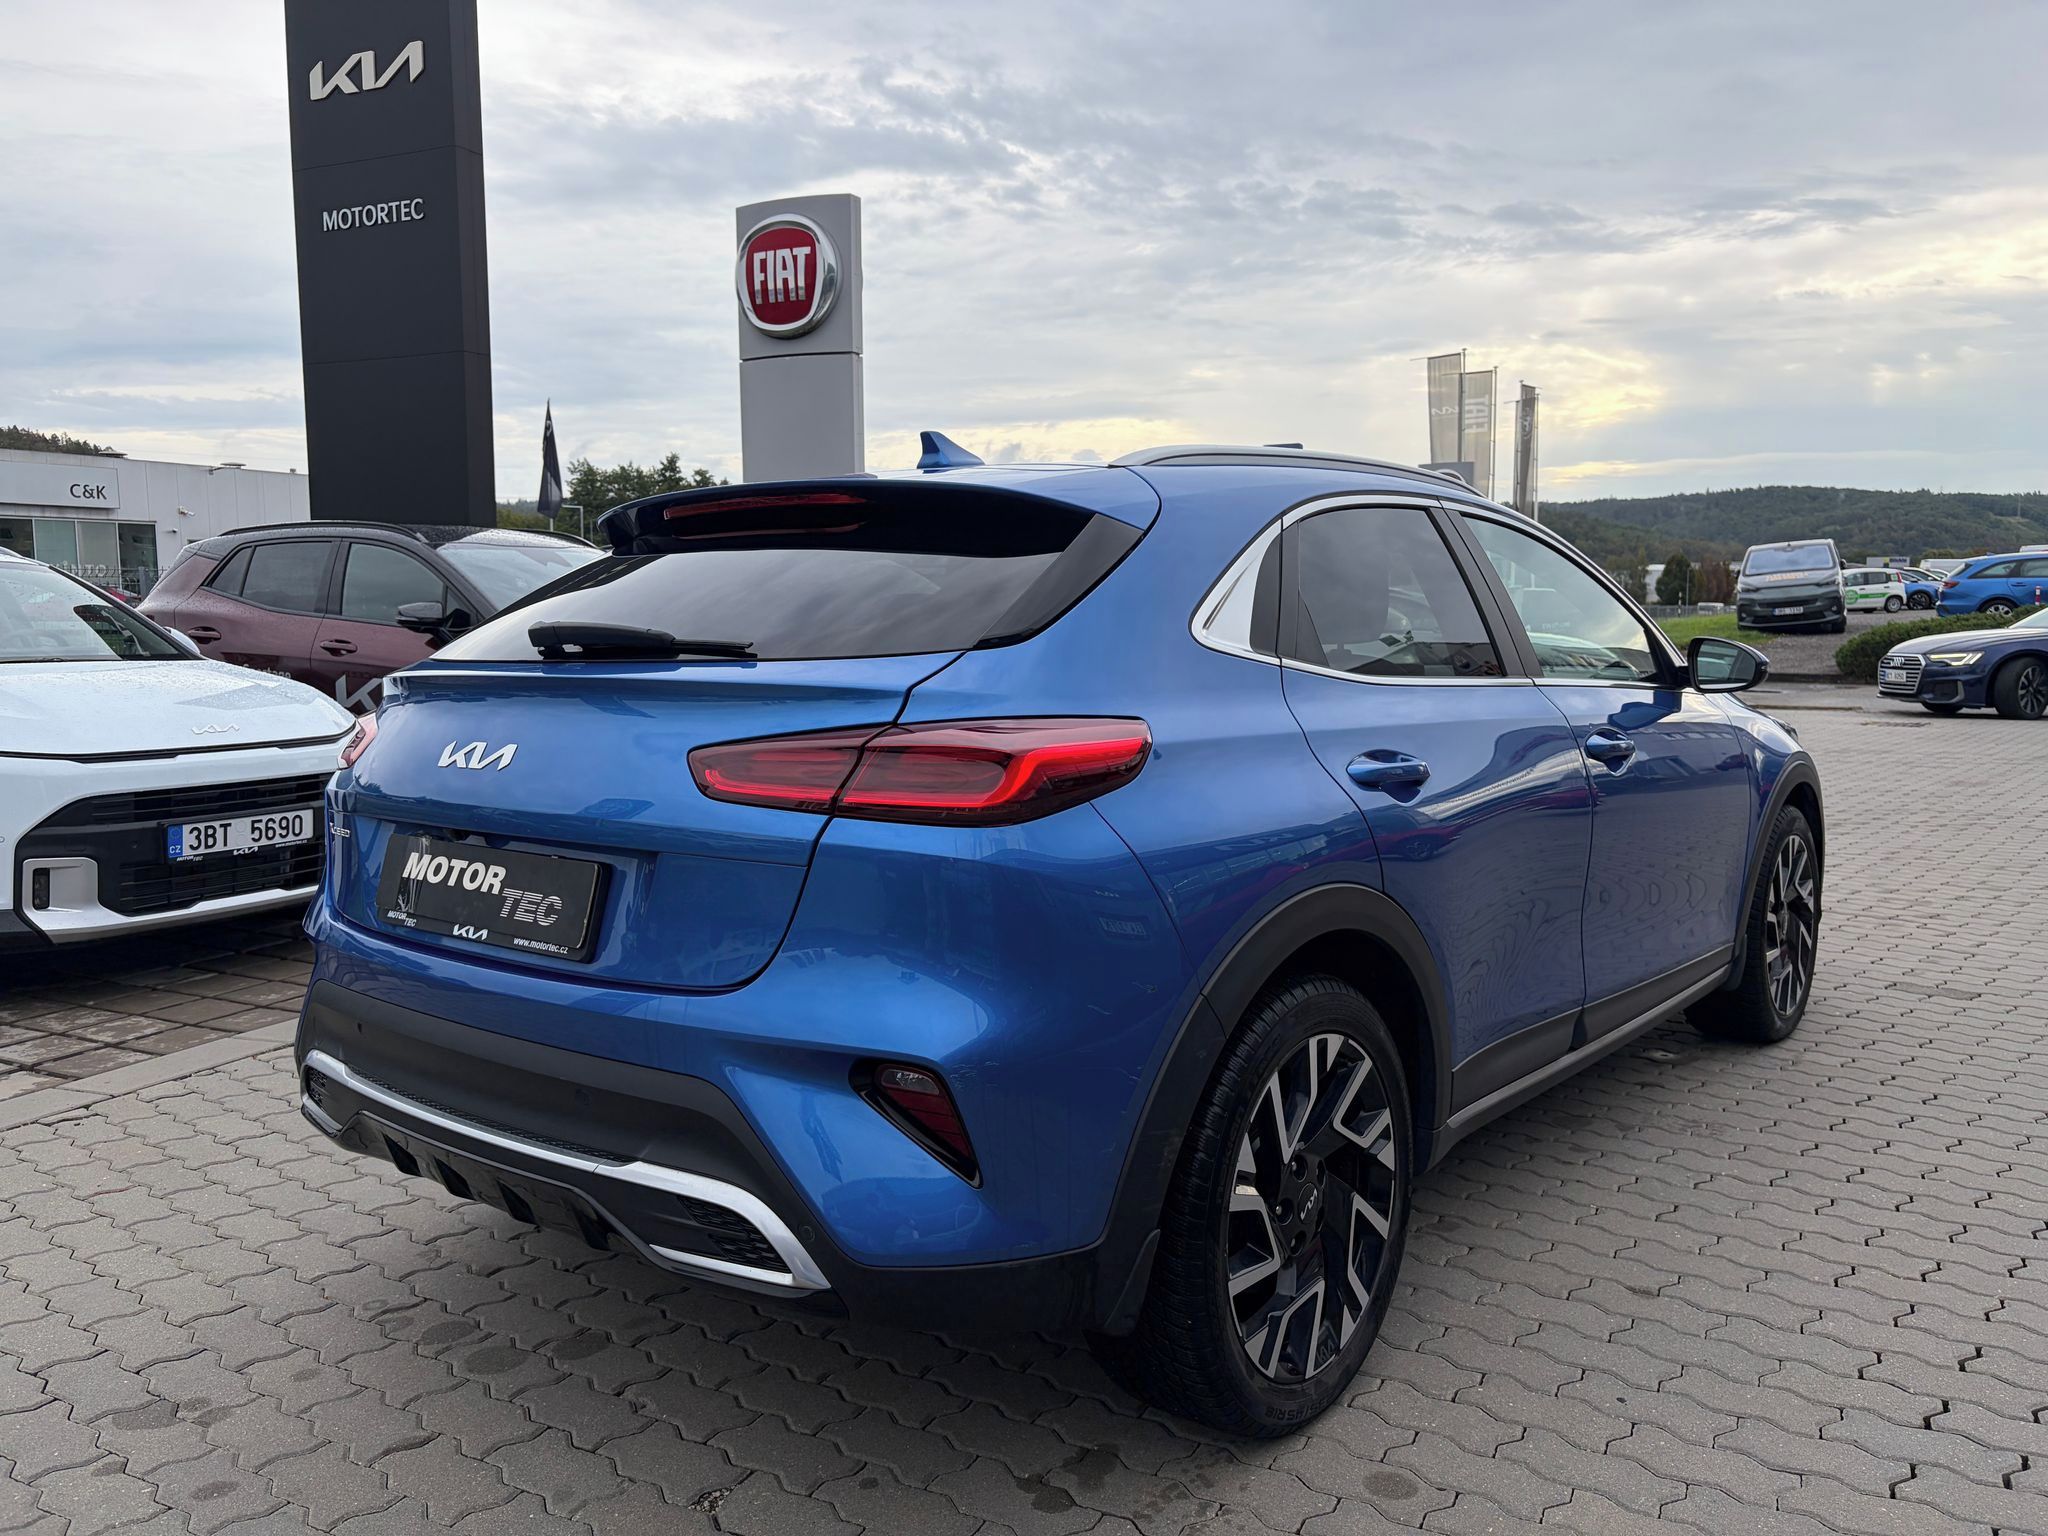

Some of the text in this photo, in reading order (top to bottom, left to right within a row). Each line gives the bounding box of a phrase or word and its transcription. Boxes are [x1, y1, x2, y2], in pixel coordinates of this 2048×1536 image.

[309, 40, 424, 101] KIA
[322, 198, 424, 232] MOTORTEC
[753, 246, 811, 305] FIAT
[69, 483, 107, 500] C&K
[437, 740, 518, 771] KIA
[188, 814, 304, 851] 3BT 5690
[169, 845, 181, 854] CZ
[233, 846, 259, 856] KIA
[401, 852, 507, 895] MOTOR
[387, 910, 407, 920] MOTOR
[500, 888, 563, 926] TEC
[404, 917, 417, 927] TEC
[452, 923, 489, 941] KIA
[513, 936, 569, 954] www.motortec.cz
